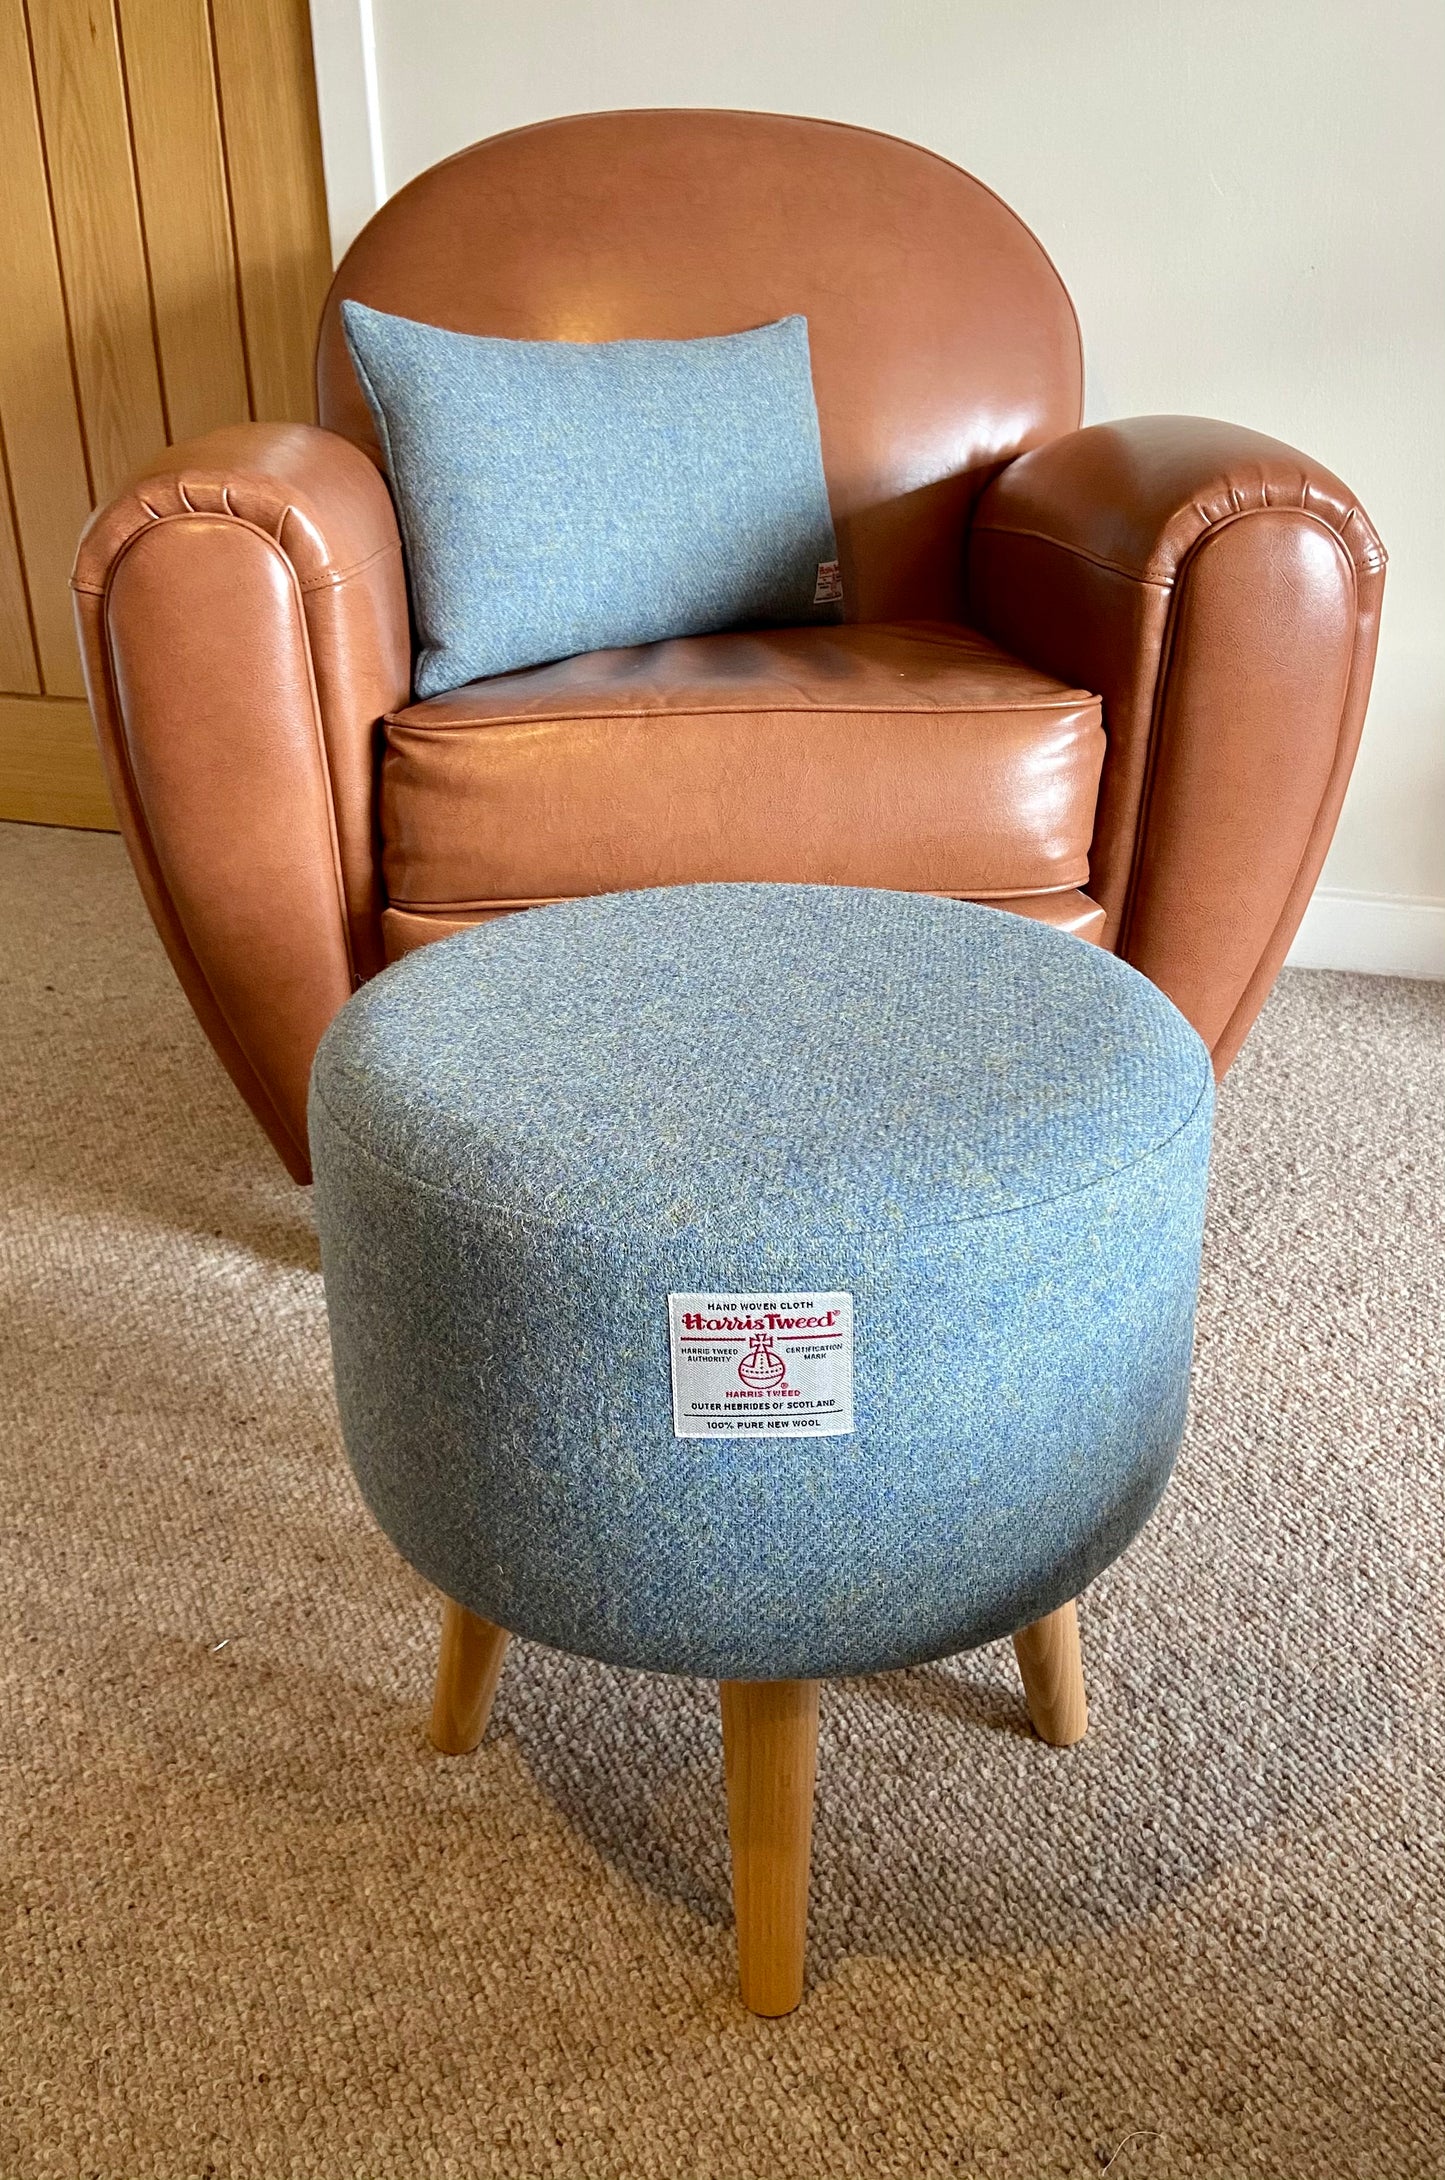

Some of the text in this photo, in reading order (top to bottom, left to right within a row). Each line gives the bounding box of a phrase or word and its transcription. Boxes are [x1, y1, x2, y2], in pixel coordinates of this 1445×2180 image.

[740, 1302, 777, 1310] WOVEN
[692, 1402, 721, 1410] OUTER
[787, 1399, 835, 1408] SCOTLAND
[738, 1421, 763, 1429] PURE
